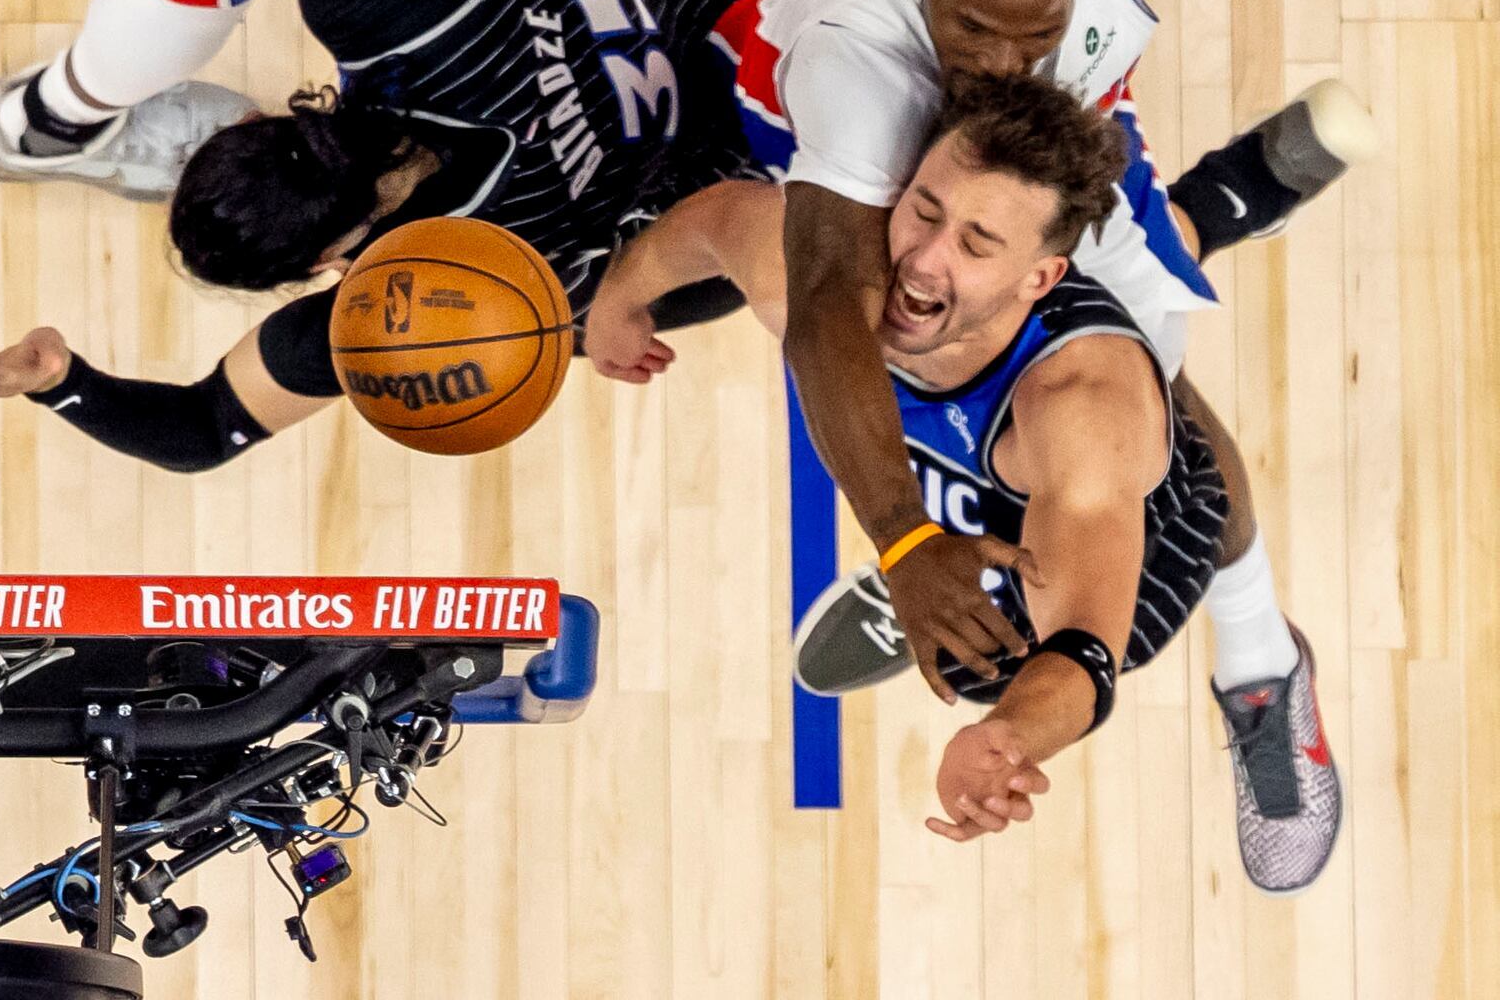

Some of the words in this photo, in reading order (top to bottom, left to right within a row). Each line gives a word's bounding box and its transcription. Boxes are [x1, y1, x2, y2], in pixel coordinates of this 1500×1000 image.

[524, 7, 604, 201] BITADZE
[344, 360, 493, 412] Wilson
[140, 584, 354, 629] Emirates
[373, 586, 427, 630] FLY
[434, 586, 546, 631] BETTER
